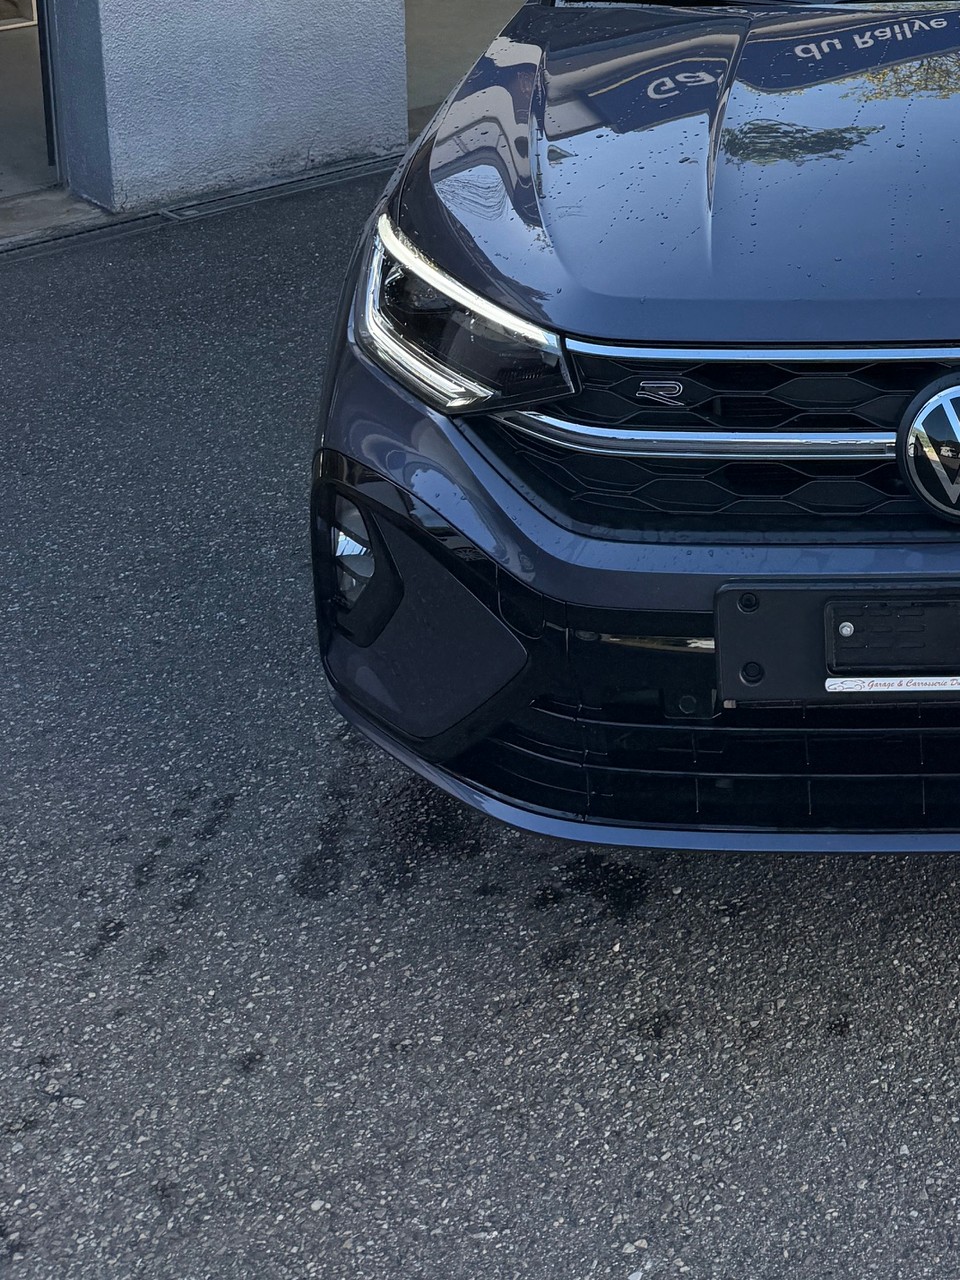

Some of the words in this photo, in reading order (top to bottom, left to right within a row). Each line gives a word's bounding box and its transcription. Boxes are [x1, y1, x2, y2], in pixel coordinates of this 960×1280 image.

[867, 680, 894, 690] Garage
[897, 679, 903, 687] &
[905, 679, 948, 688] Carrosserie
[950, 678, 960, 686] Du
